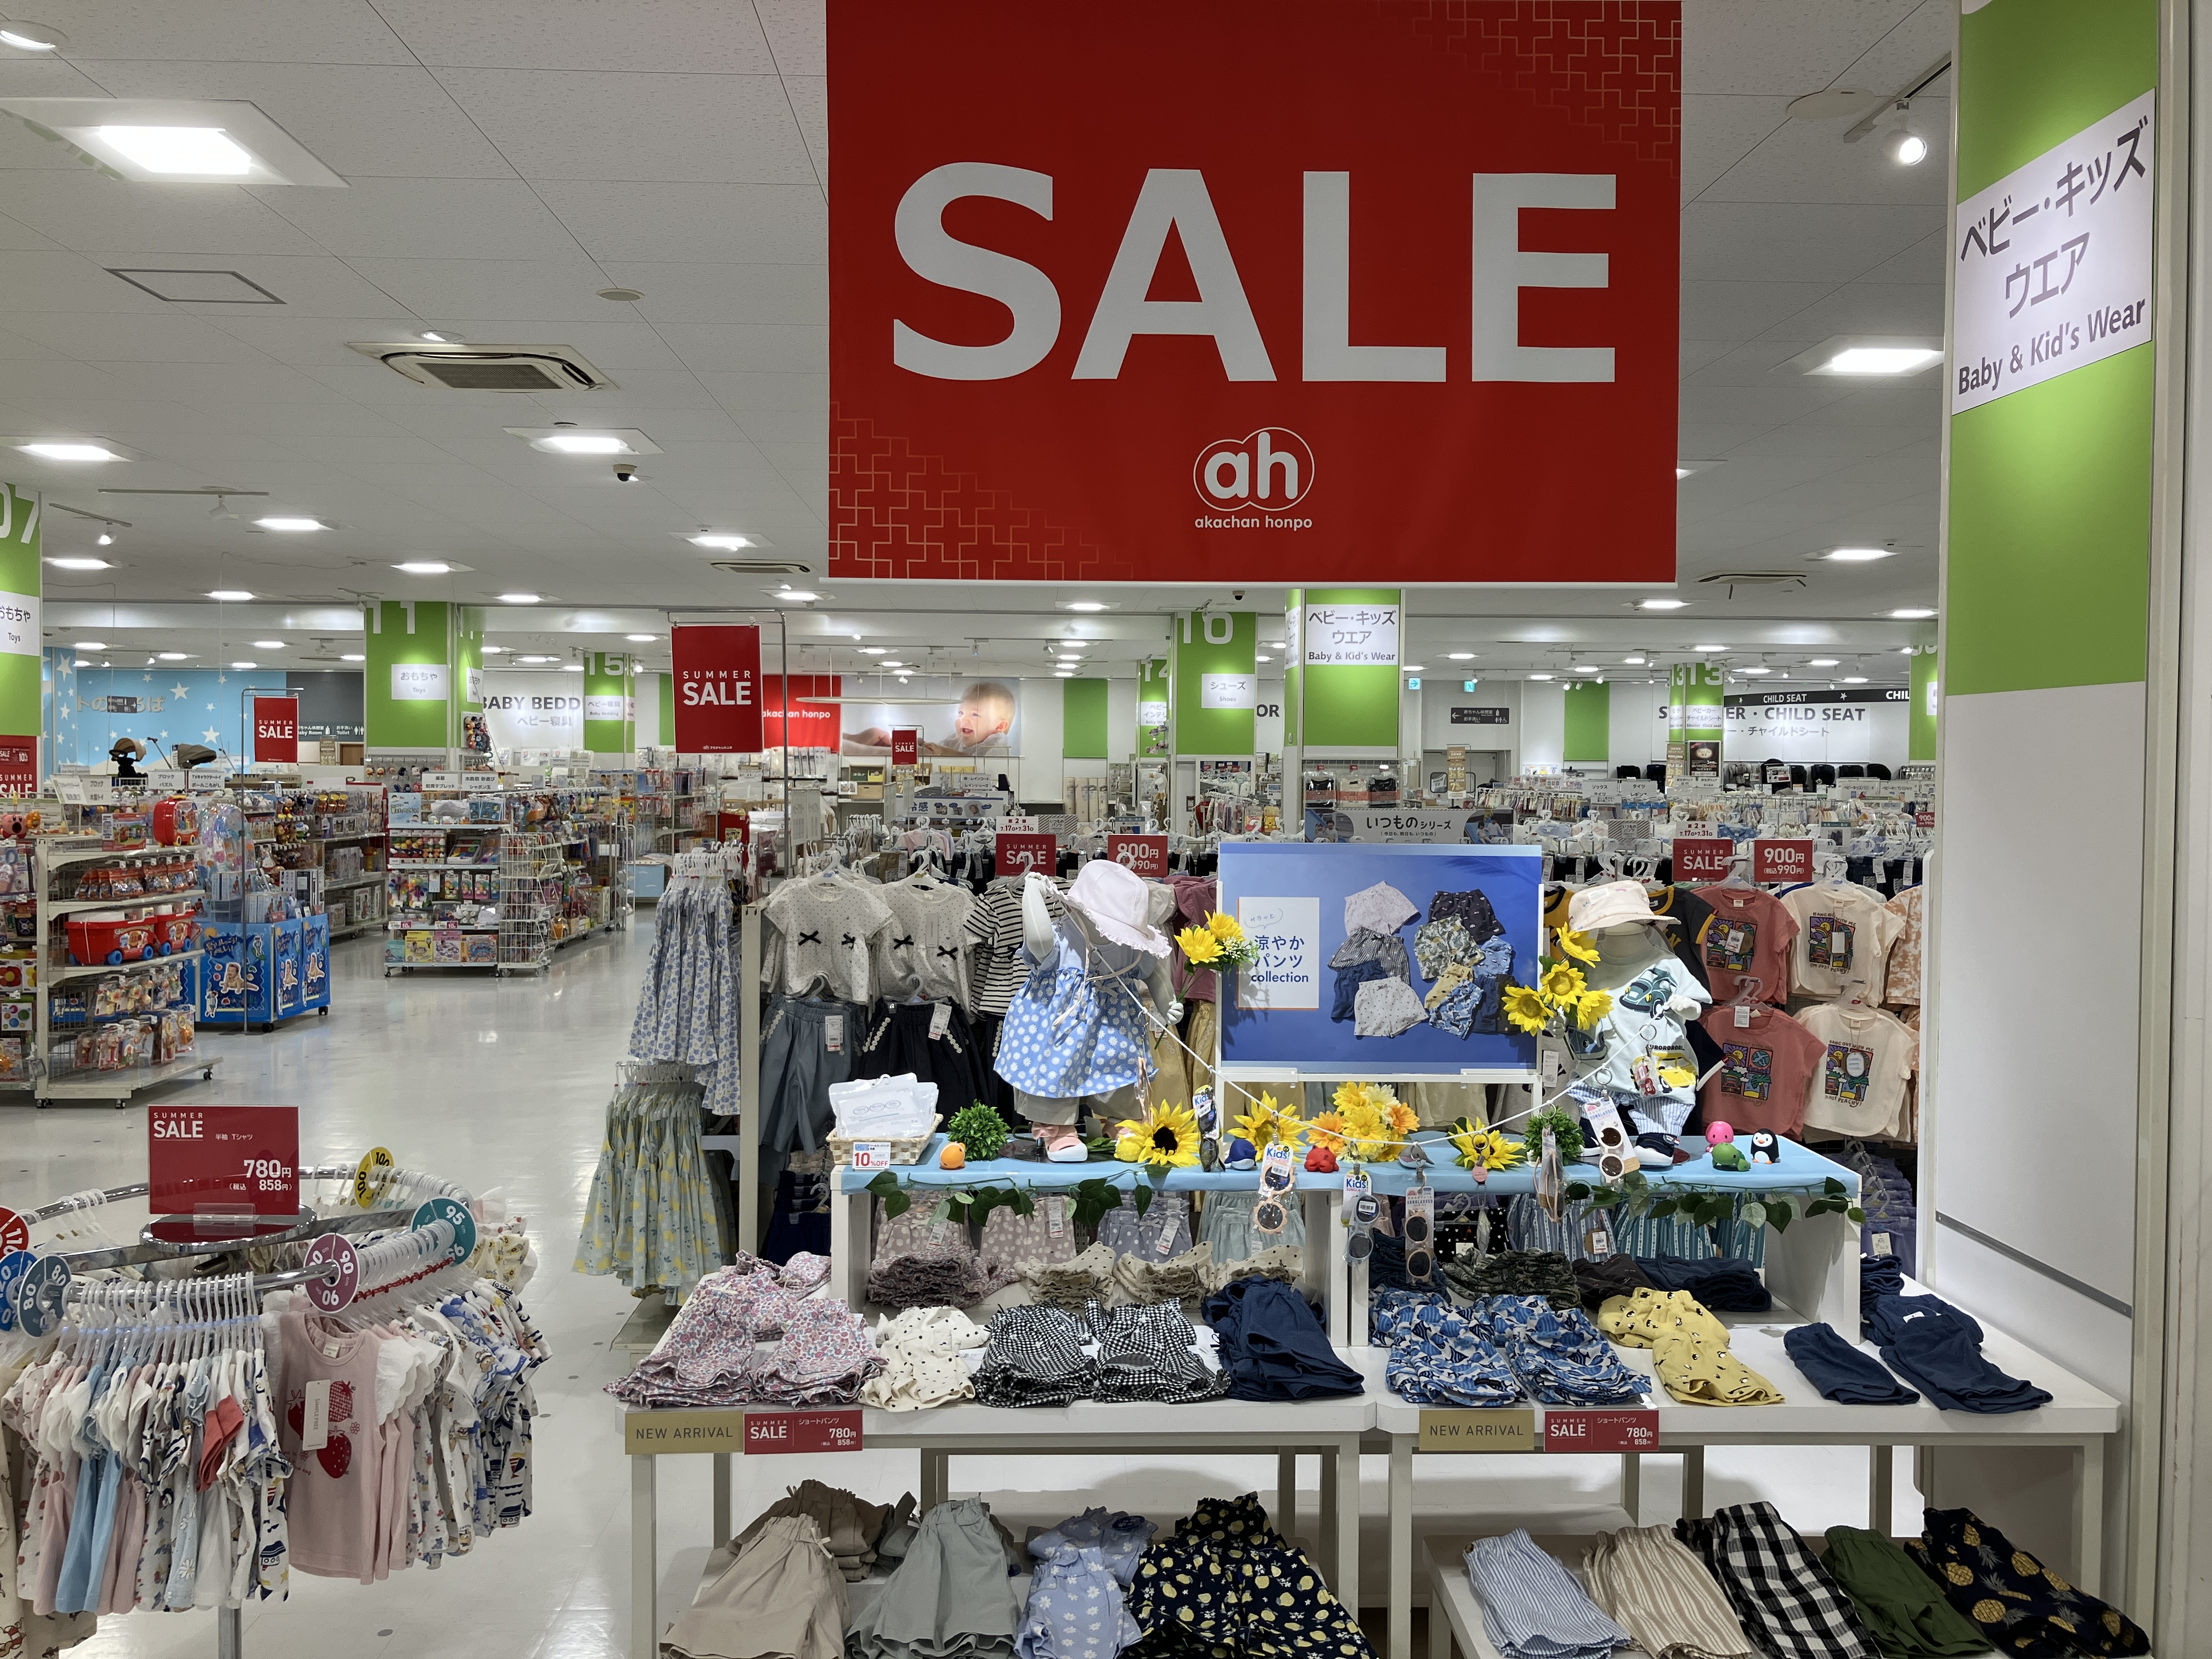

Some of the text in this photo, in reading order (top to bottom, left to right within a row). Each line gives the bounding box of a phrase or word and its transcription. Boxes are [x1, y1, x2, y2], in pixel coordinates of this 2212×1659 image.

[1961, 115, 2148, 261] ベビー・キッズ
[894, 162, 1616, 382] SALE
[2005, 232, 2090, 318] ウエア
[1959, 299, 2145, 391] Baby & Kid's Wear
[1204, 431, 1298, 500] ah
[1195, 515, 1313, 532] akachan honpo
[1308, 610, 1396, 625] ベビー・キッズ
[1177, 612, 1233, 644] 10
[8, 632, 21, 644] Toys
[1333, 630, 1372, 644] ウエア
[585, 652, 624, 675] 15
[1308, 651, 1331, 662] Baby
[1335, 652, 1342, 660] &
[1345, 651, 1368, 660] Kid's
[1372, 652, 1396, 660] Wear
[400, 672, 437, 680] おもちゃ
[683, 670, 751, 679] SUMMER
[1686, 663, 1723, 685] 13
[1210, 681, 1246, 690] シューズ
[683, 681, 752, 706] SALE
[1763, 693, 1807, 703] CHILD SEAT
[517, 715, 573, 726] ベビー寝具
[802, 709, 831, 720] honpo
[1764, 707, 1866, 721] CHILD SEAT
[258, 725, 293, 739] SALE
[1366, 815, 1451, 830] いつものシリーズ
[1764, 848, 1804, 863] 900円
[1683, 856, 1723, 870] SALE
[1763, 865, 1804, 874] (税込990円)
[1250, 913, 1274, 922] サラッと
[1254, 935, 1305, 950] 涼やか
[1254, 953, 1302, 968] パンツ
[1251, 970, 1309, 983] collection
[154, 1120, 204, 1138] SALE
[244, 1159, 291, 1178] 780円
[1346, 1178, 1369, 1188] Kids!
[446, 1205, 465, 1225] 95
[340, 1250, 354, 1274] 90
[52, 1264, 66, 1286] 80
[23, 1283, 36, 1311] 80
[798, 1417, 839, 1425] ショートパンツ
[636, 1426, 733, 1440] NEW ARRIVAL
[750, 1426, 787, 1440] SALE
[829, 1427, 856, 1438] 780円
[1430, 1425, 1524, 1436] NEW ARRIVAL
[1550, 1424, 1586, 1437] SALE
[1626, 1427, 1652, 1438] 780円
